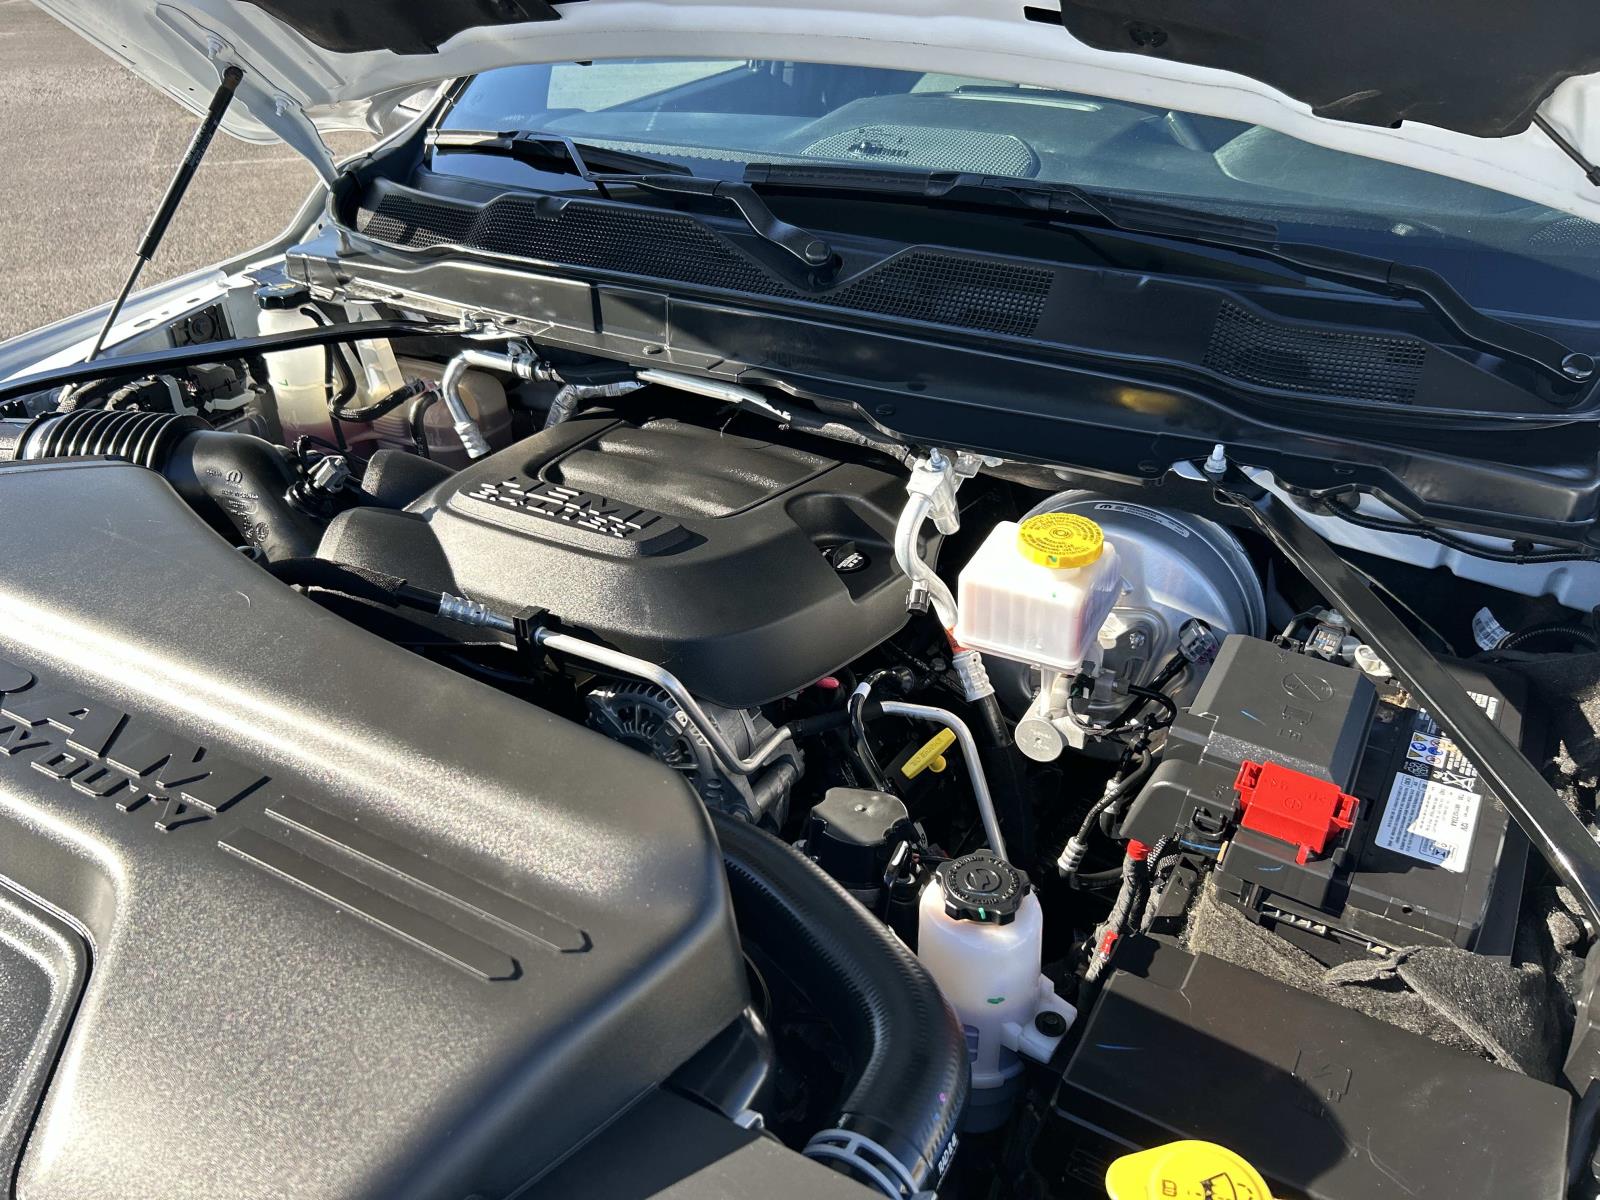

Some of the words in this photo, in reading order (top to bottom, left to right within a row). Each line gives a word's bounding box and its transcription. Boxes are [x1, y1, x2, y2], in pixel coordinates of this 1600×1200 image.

[481, 477, 662, 529] HEMI
[526, 500, 635, 538] LITER
[31, 751, 213, 832] DUTY
